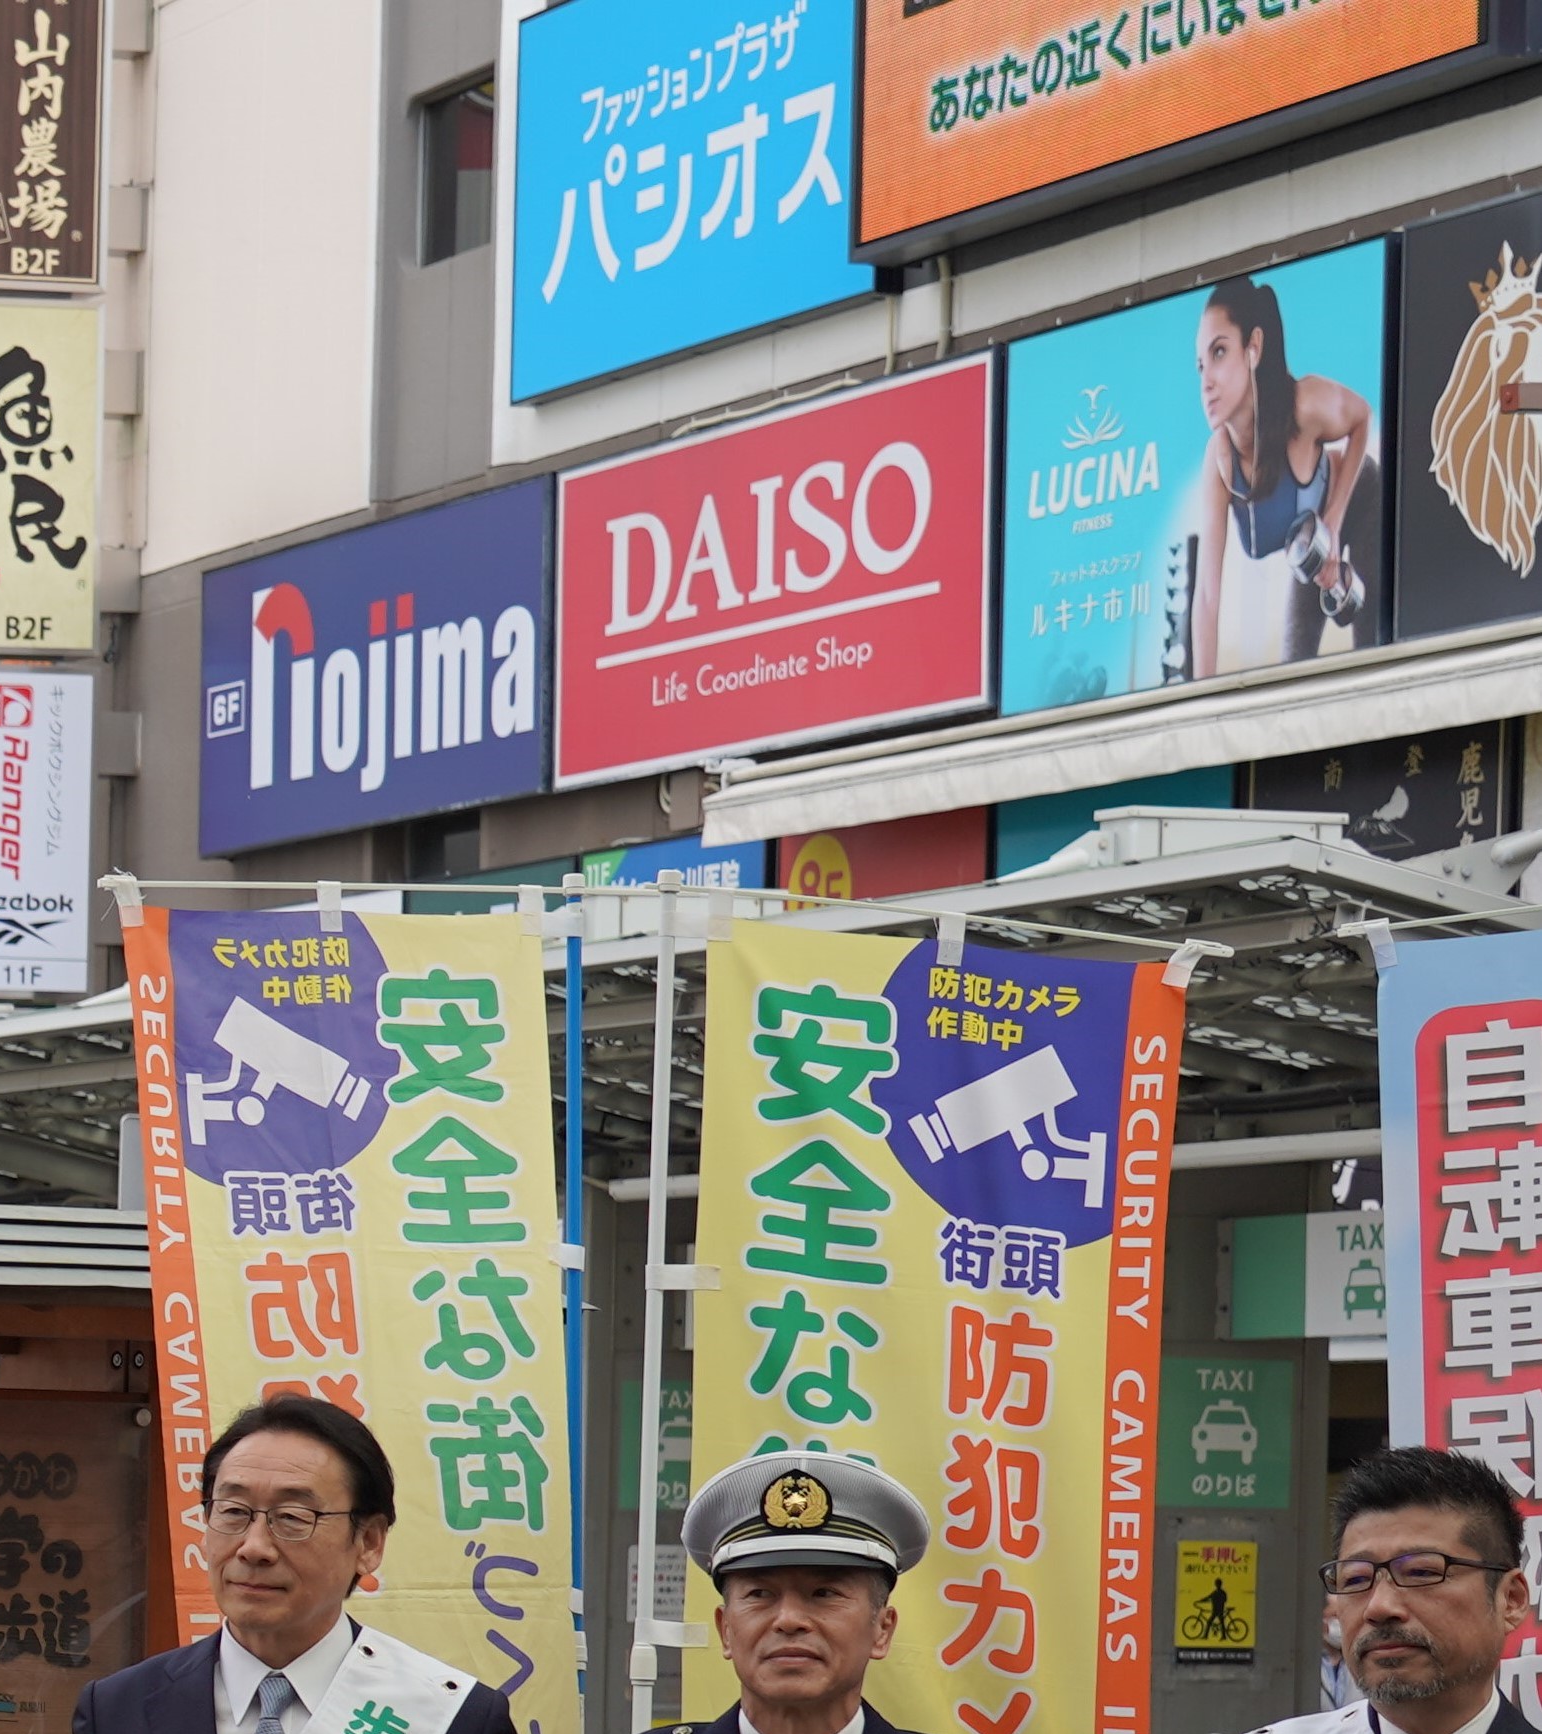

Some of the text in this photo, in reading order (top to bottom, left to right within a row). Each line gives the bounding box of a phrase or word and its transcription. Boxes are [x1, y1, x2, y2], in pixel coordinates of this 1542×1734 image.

[581, 0, 808, 143] ファッションプラザ
[8, 10, 70, 241] 山内農場
[542, 83, 844, 304] パシオス
[10, 248, 61, 275] B2F
[1028, 442, 1161, 521] LUCINA
[604, 441, 933, 637] DAISO
[1071, 513, 1114, 536] FITNESS
[4, 616, 53, 641] B2F
[1029, 581, 1153, 640] ルキナ市川
[651, 636, 873, 708] Life Coordinate Shop
[211, 686, 242, 730] 6F
[2, 966, 44, 986] 11F
[928, 967, 1082, 1018] 防犯カメラ
[926, 1007, 1024, 1051] 作動中
[1117, 1034, 1167, 1330] SECURITY
[939, 1219, 1061, 1299] 街頭
[1196, 1368, 1254, 1392] TAXI
[1191, 1472, 1256, 1498] のりば
[1107, 1369, 1147, 1664] CAMERAS
